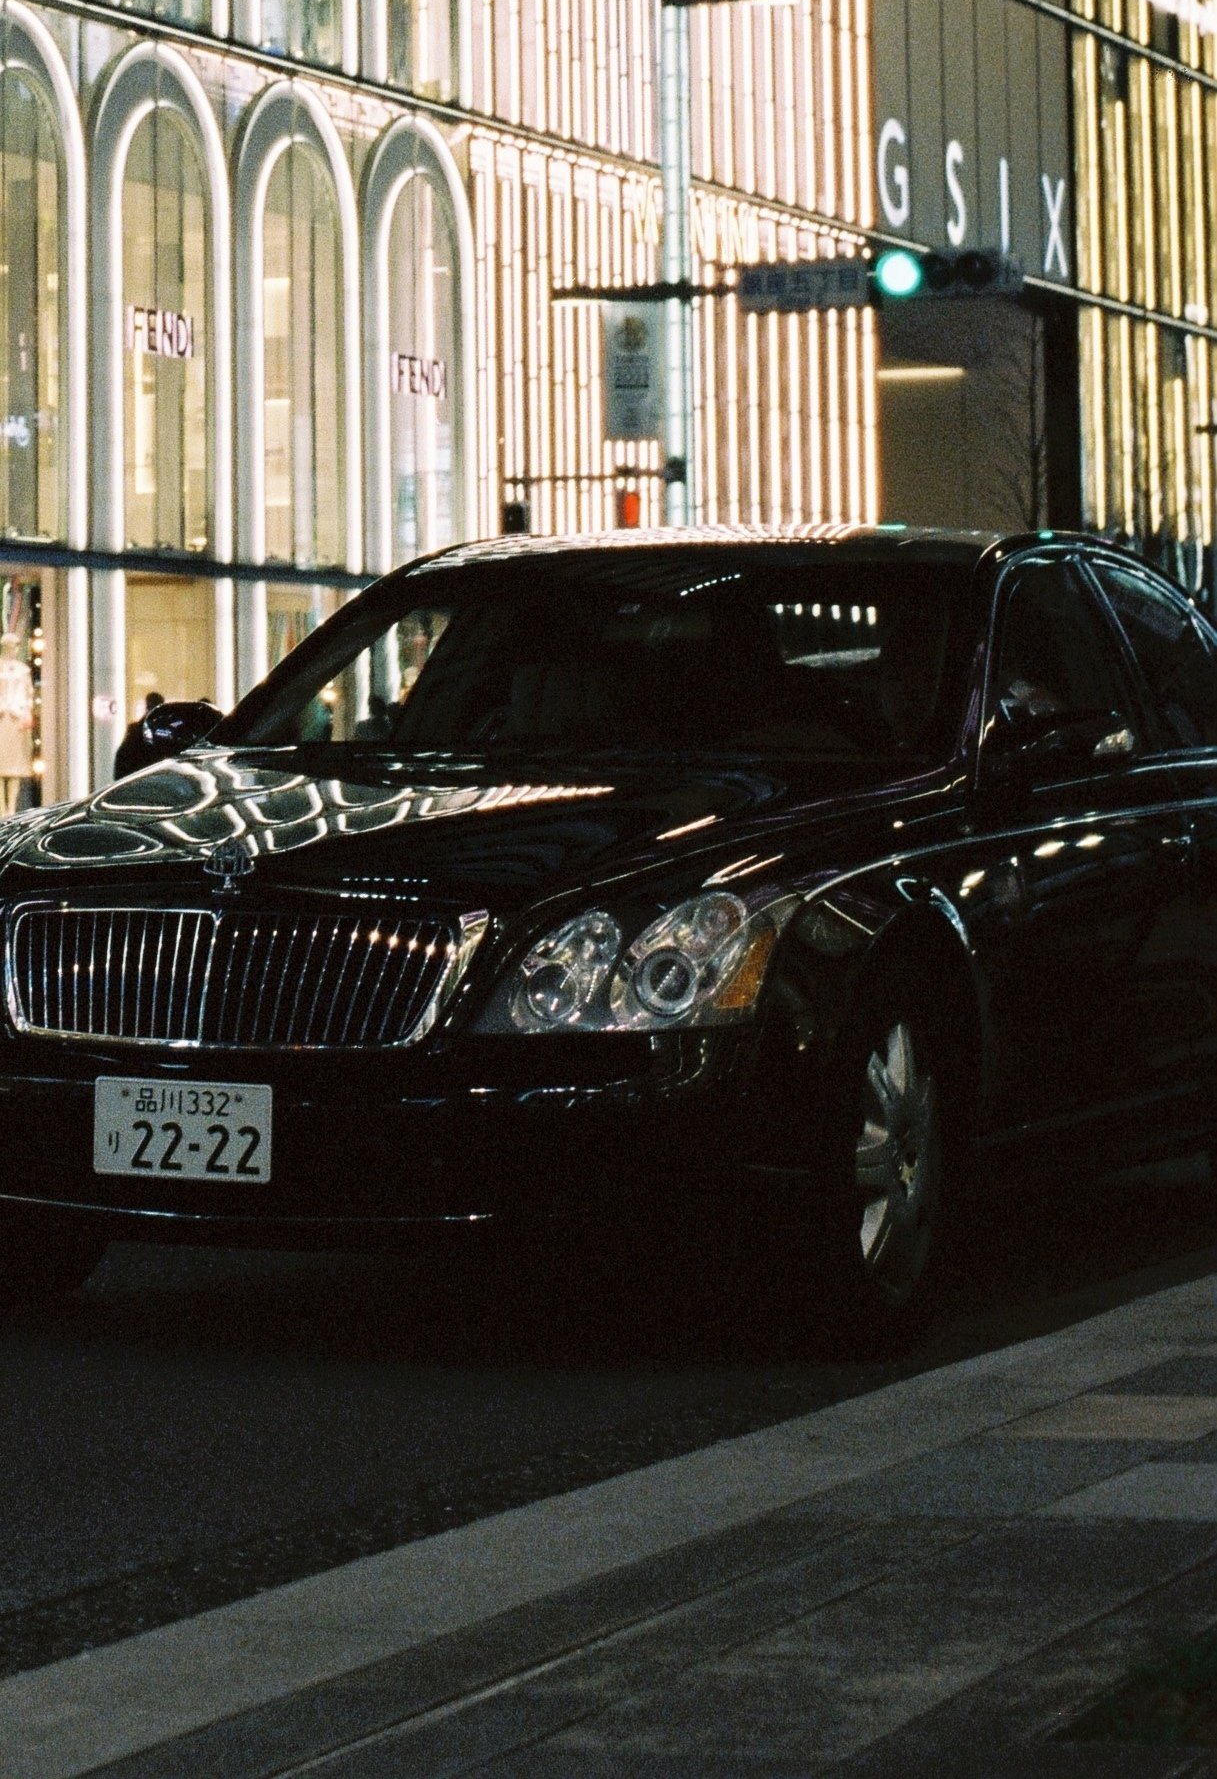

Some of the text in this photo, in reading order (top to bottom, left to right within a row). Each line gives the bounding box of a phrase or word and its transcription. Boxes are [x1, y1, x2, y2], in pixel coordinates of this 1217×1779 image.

[877, 118, 1068, 278] GSIX
[126, 305, 194, 360] FENDI
[391, 352, 447, 399] FENDI
[131, 1120, 261, 1175] 22-22
